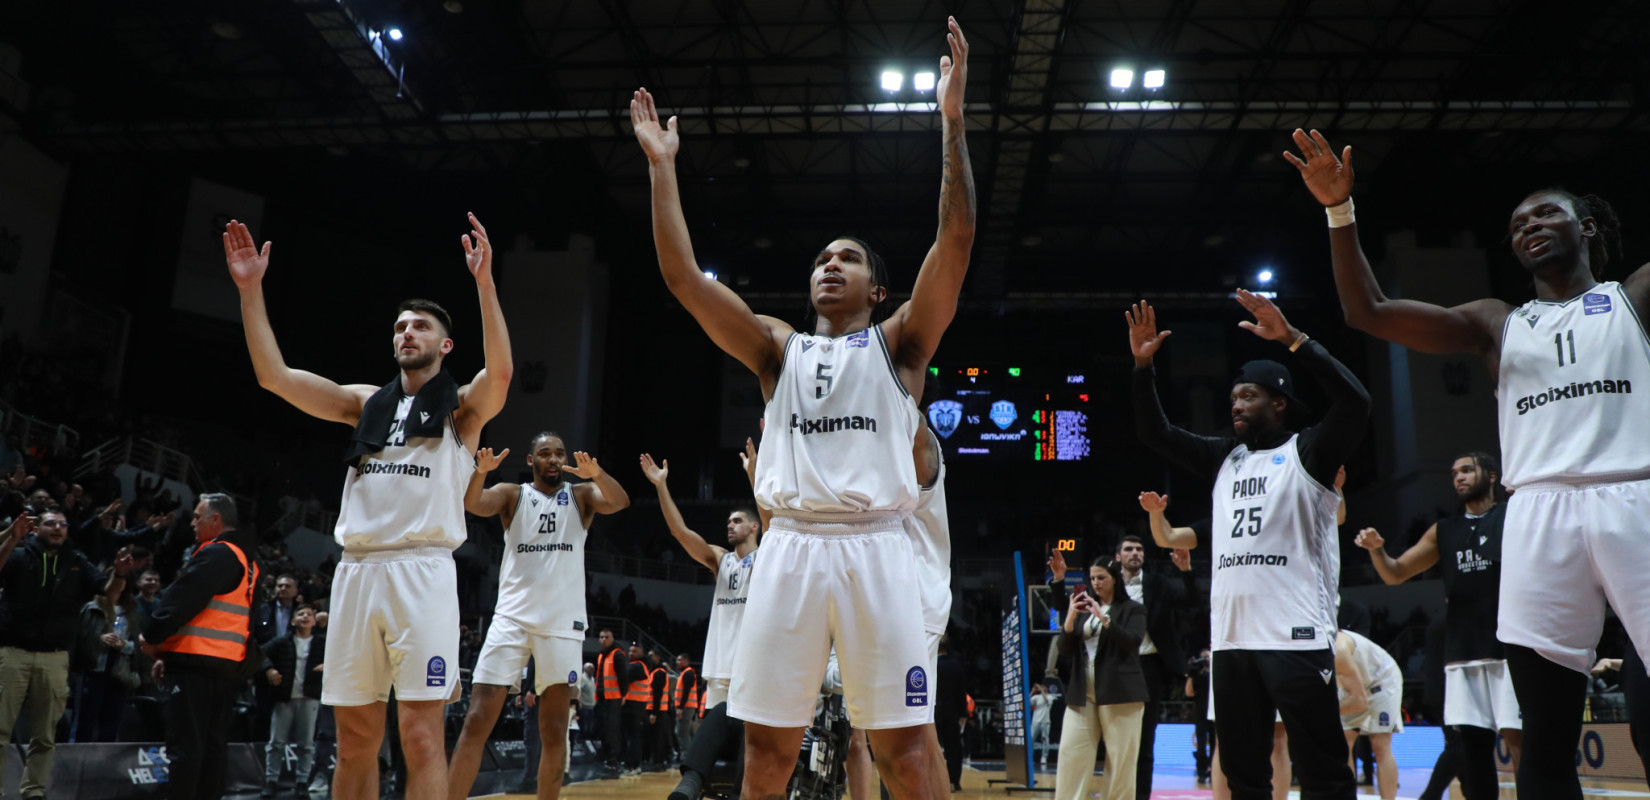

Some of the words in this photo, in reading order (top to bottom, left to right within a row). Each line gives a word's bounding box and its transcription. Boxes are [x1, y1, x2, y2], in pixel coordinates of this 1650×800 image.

[1555, 329, 1577, 367] 11
[816, 363, 833, 399] 5
[1516, 379, 1632, 416] Stoiximan
[790, 412, 877, 436] tiximan
[967, 415, 980, 424] VS
[1232, 476, 1268, 500] PAOK
[538, 511, 556, 533] 26
[1231, 506, 1262, 538] 25
[517, 542, 573, 554] Stoiximan
[1218, 552, 1288, 571] Stoiximan
